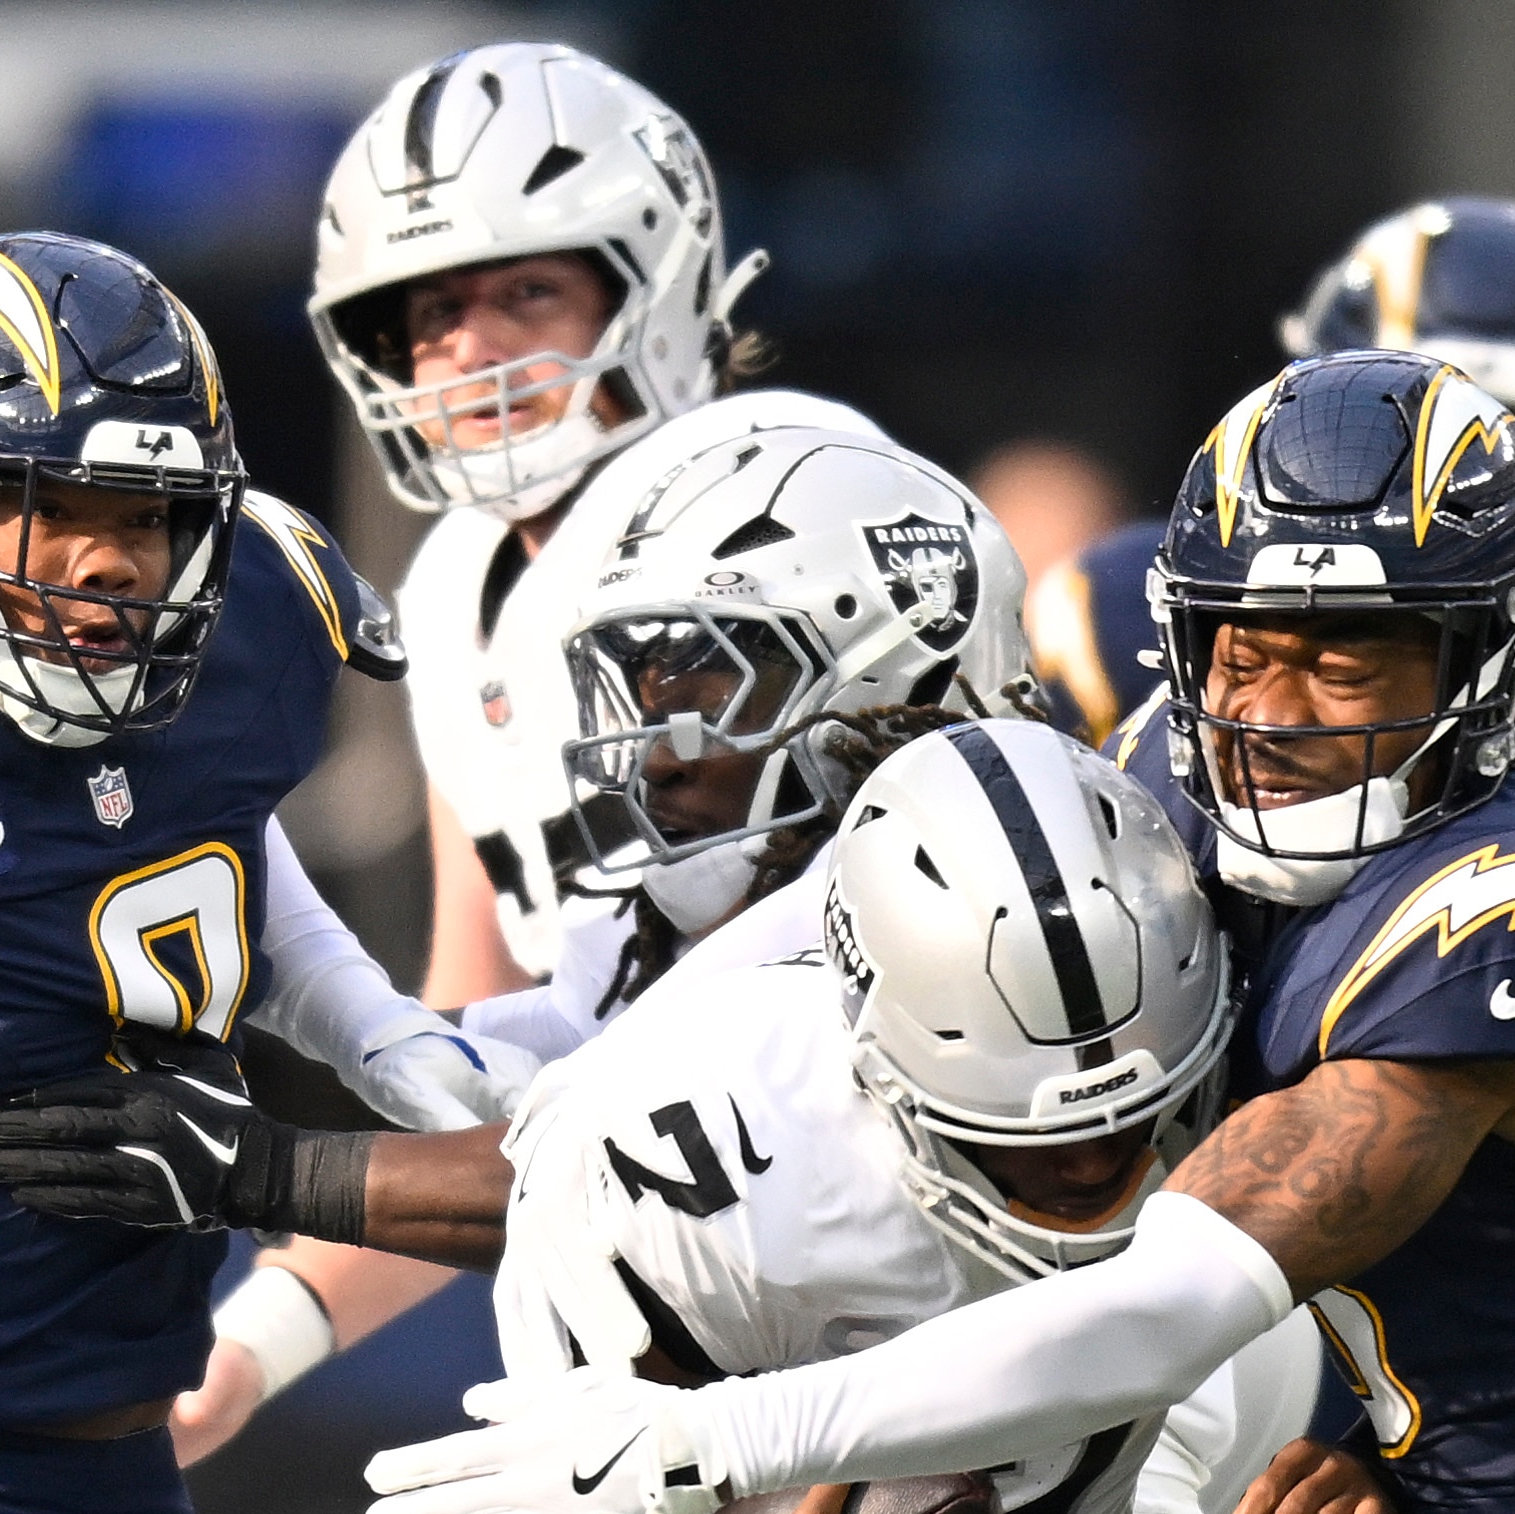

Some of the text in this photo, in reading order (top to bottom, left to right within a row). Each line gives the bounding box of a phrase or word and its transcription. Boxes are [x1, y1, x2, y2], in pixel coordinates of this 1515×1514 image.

[873, 526, 962, 543] RAIDERS
[1293, 547, 1336, 578] LA
[694, 585, 759, 598] OAKLEY
[100, 791, 129, 818] NFL
[1059, 1067, 1139, 1105] RAIDERS
[602, 1099, 741, 1219] 7
